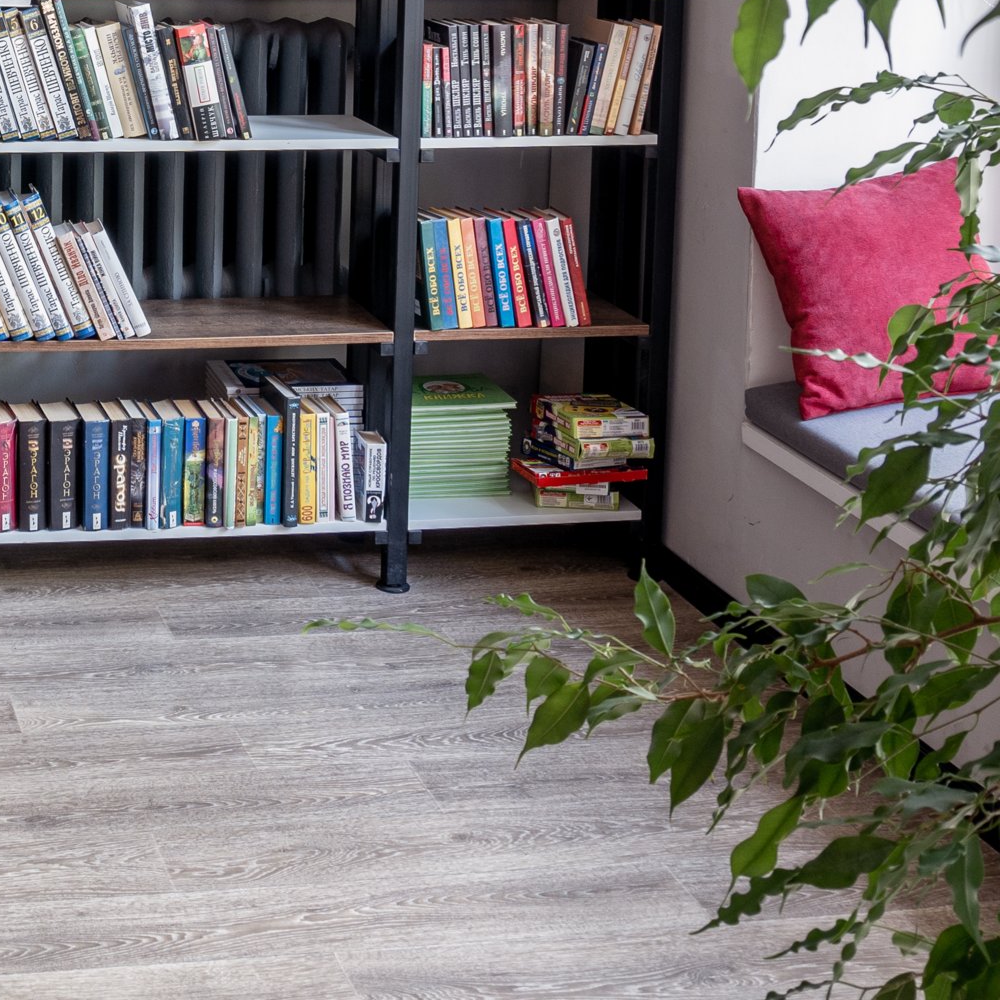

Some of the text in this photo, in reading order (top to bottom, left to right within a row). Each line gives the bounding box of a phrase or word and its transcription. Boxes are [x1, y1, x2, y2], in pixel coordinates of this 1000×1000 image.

[14, 37, 45, 117] Тарас ШЕВЧЕНКО
[34, 39, 66, 118] Тарас ШЕВЧЕНКО
[15, 95, 28, 118] Тарас
[1, 233, 40, 316] Тарас ШЕВЧЕНКО
[20, 232, 58, 314] Тарас ШЕВЧЕНКО
[427, 247, 435, 271] ВСЕХ
[495, 243, 510, 311] ВСЁ ОБО ВСЕХ
[510, 245, 527, 313] ВСЁ ОБО ВСЕХ
[0, 288, 16, 315] Тарас
[429, 297, 440, 315] ВСЁ
[340, 440, 349, 460] МИР
[341, 463, 352, 501] ПОЗНАЮ
[302, 506, 313, 521] 600
